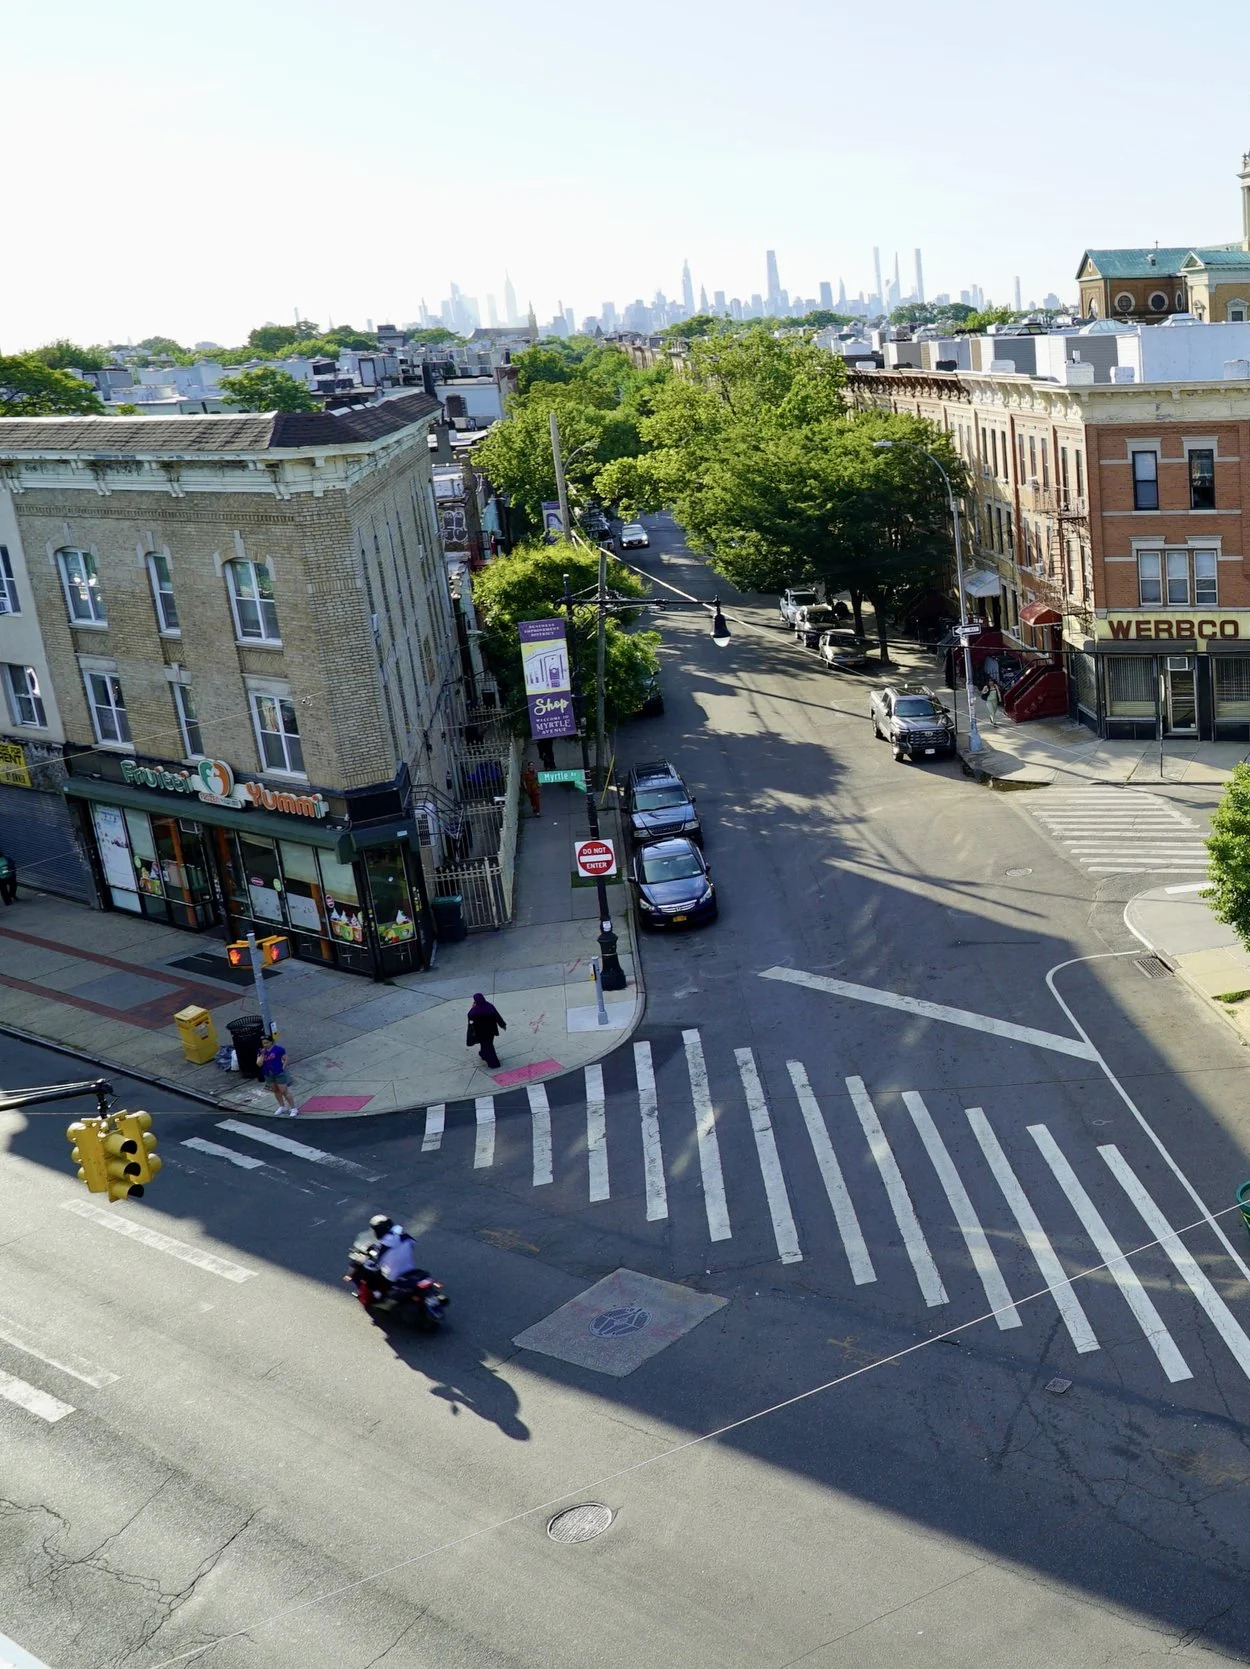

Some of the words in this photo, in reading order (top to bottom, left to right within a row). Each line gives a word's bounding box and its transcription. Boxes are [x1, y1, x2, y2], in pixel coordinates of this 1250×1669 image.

[1108, 620, 1239, 639] WERBCO
[534, 698, 569, 716] Shop
[536, 719, 572, 732] MYRTLE
[544, 772, 569, 782] Myrtle
[246, 782, 324, 819] Yummi
[593, 846, 606, 854] NOT
